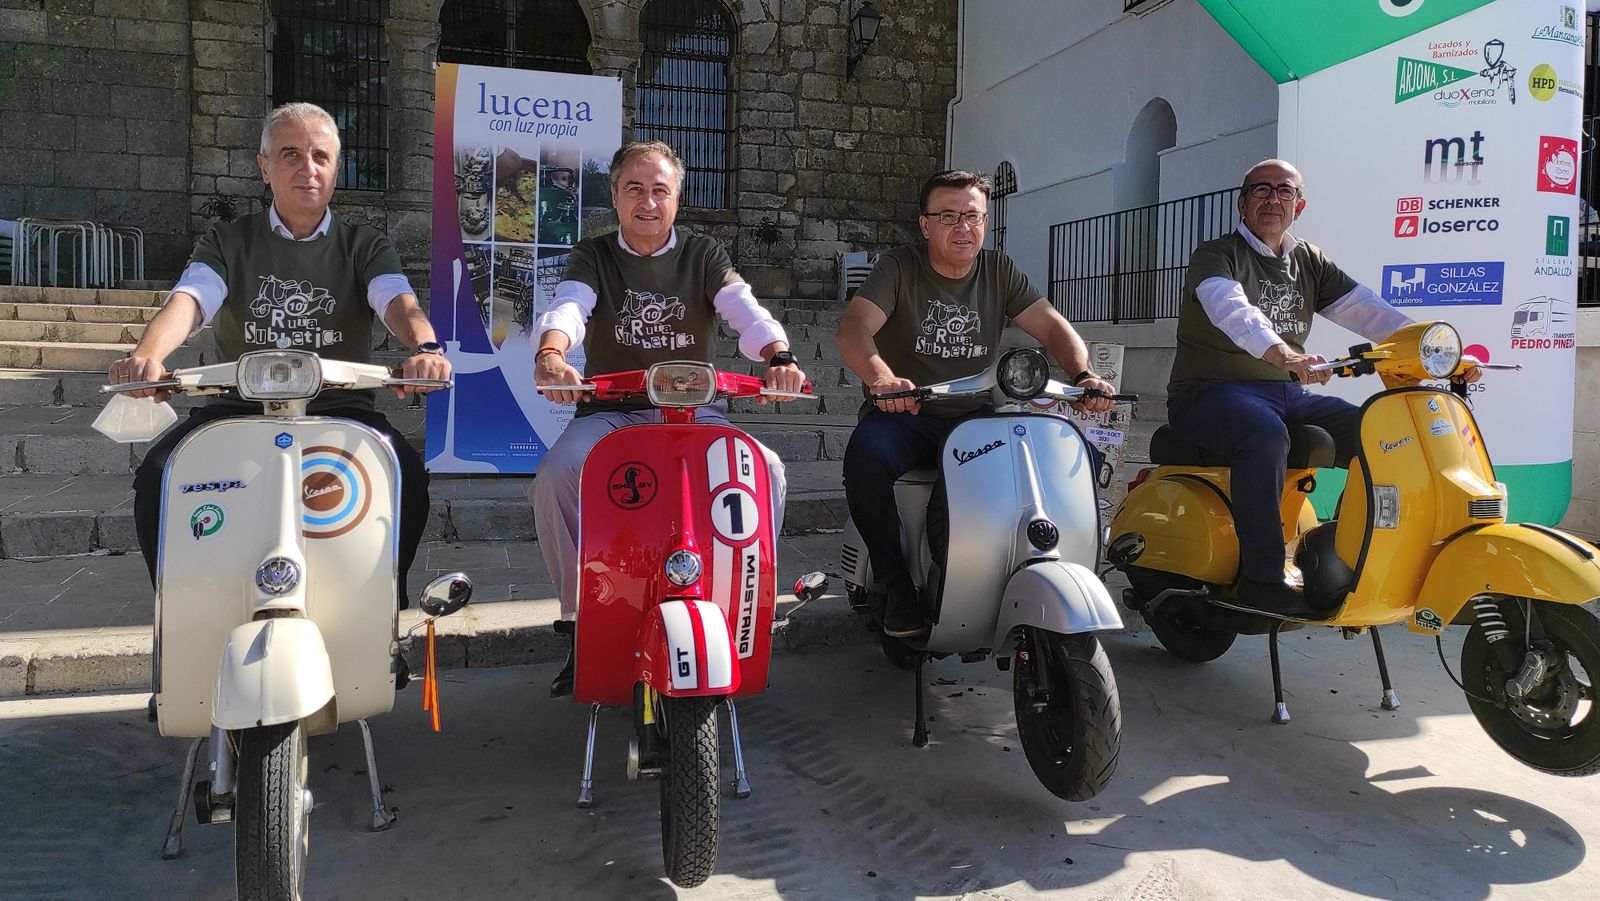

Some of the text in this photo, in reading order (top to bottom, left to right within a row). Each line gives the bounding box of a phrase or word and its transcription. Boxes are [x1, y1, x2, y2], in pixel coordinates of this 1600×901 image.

[1428, 40, 1471, 50] Lacados y
[1432, 48, 1478, 59] Barnizados
[1398, 60, 1439, 96] ARJONA,
[1532, 77, 1555, 90] HPD
[477, 82, 592, 122] lucena
[489, 117, 578, 139] con luz propia
[1425, 131, 1484, 164] mt
[1400, 198, 1500, 212] DB SCHENKER
[1422, 218, 1499, 234] loserco
[1440, 267, 1486, 279] SILLAS
[1533, 267, 1572, 277] ANDALUZA
[1427, 280, 1499, 294] GONZÁLEZ
[1511, 339, 1551, 349] PEDRO
[952, 440, 1007, 466] Vespa
[740, 450, 750, 477] GT
[179, 479, 247, 493] vespa
[305, 484, 342, 499] Vespa
[722, 493, 744, 534] 1
[738, 555, 756, 654] MUSTANG
[677, 648, 690, 677] GT
